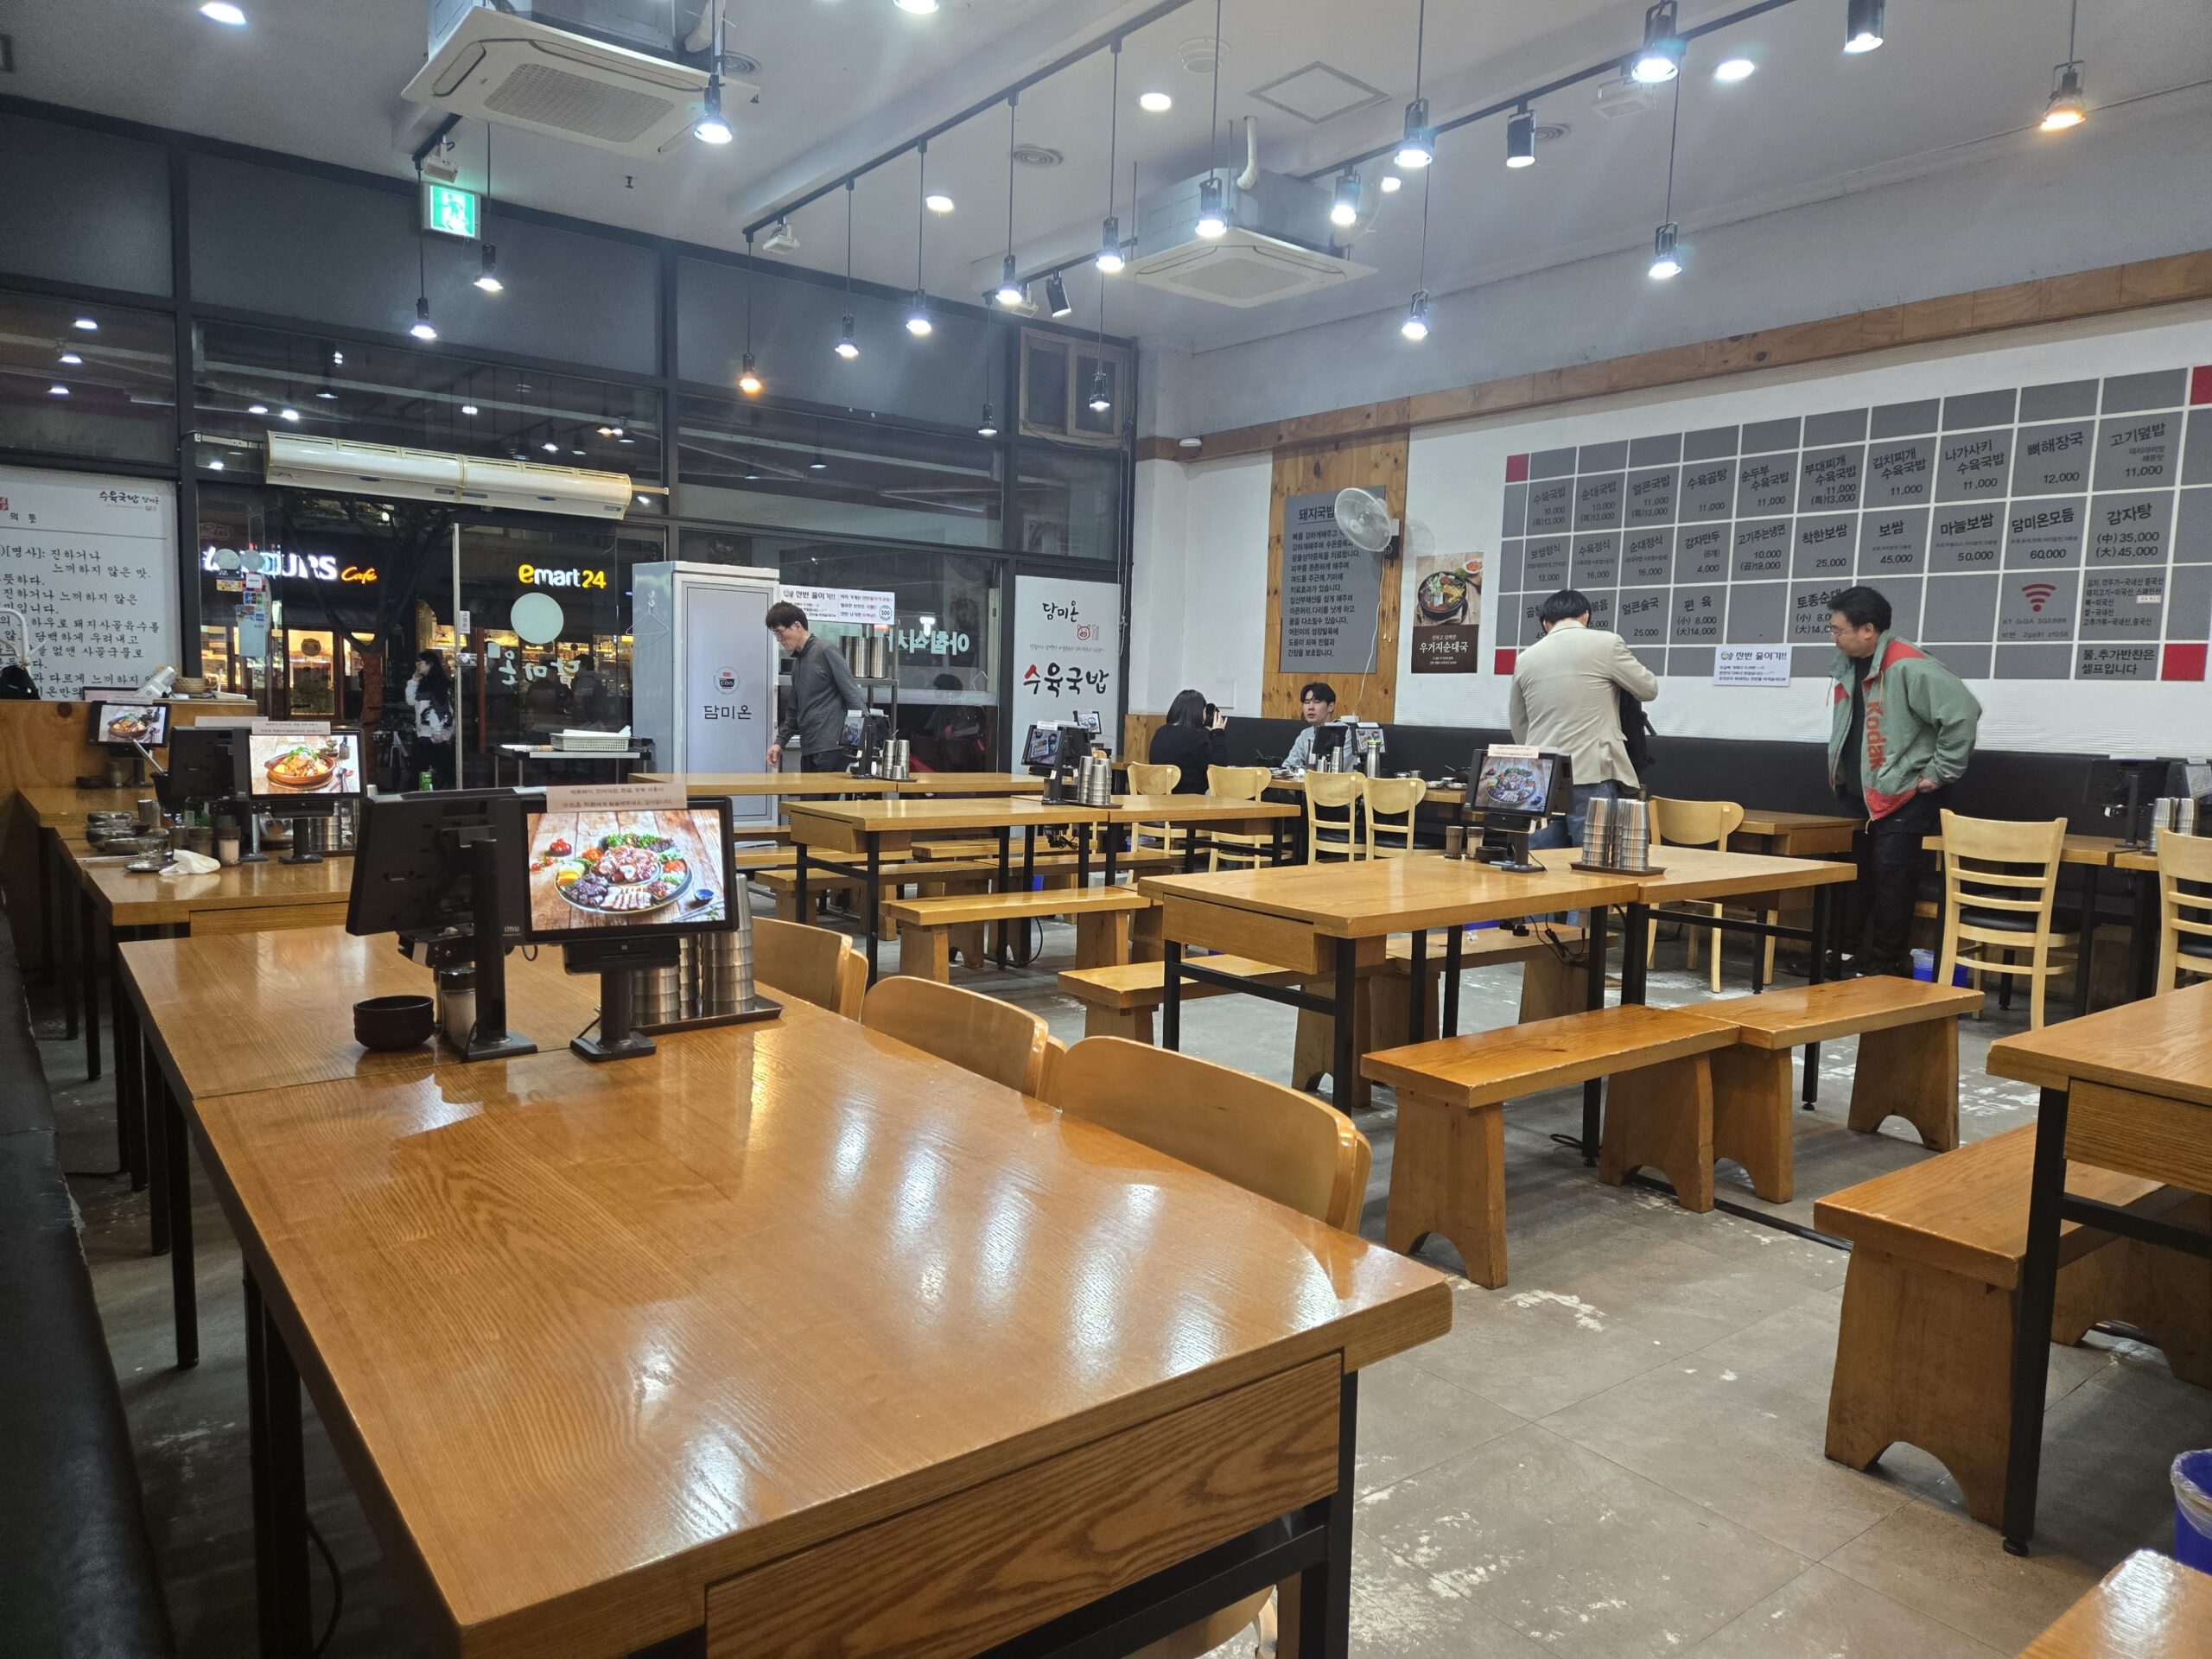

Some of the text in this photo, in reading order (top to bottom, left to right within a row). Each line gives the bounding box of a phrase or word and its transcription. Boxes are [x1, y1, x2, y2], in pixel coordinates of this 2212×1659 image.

[2110, 423, 2166, 447] 고기덮밥
[1872, 447, 1916, 469] 김치찌개
[1945, 439, 1992, 461] 나가사키
[1805, 454, 1847, 475] 부대찌개
[1881, 458, 1926, 480] 수육국밥
[1956, 452, 2005, 474] 수육국밥
[1687, 467, 1728, 490] 수육곰탕
[1740, 465, 1770, 483] 순두부
[1751, 472, 1789, 492] 수육국밥
[1815, 464, 1857, 486] 수육국밥
[1581, 481, 1617, 501] 순대국밥
[1632, 474, 1670, 496] 얼큰국밥
[99, 491, 139, 504] 수육국밥
[1533, 486, 1566, 505] 수육국밥
[1940, 512, 1993, 536] 마늘보쌈
[2012, 507, 2075, 534] 담미온모듬
[2107, 503, 2152, 526] 감자탕
[1738, 524, 1786, 545] 고기주는냉면
[1802, 523, 1848, 545] 착한보쌈
[1878, 520, 1904, 537] 보쌈
[1579, 539, 1611, 556] 수육정식
[1630, 535, 1663, 553] 순대정식
[1685, 531, 1720, 550] 감자만두
[50, 550, 101, 562] 진하거나
[1530, 543, 1561, 560] 보쌈정식
[53, 563, 101, 575] 느끼하지
[108, 567, 131, 578] 않은
[3, 588, 138, 606] 진하거나 느끼하지 않은
[1622, 596, 1660, 616] 얼큰술국
[1042, 600, 1079, 623] 담미온
[17, 617, 68, 629] 하우로
[35, 631, 84, 644] 담백하게
[90, 633, 139, 645] 우려내고
[1419, 641, 1469, 654] 우거지순대국
[53, 645, 144, 658] 없앤 사골국물로
[49, 674, 138, 684] 다르게 느끼하지
[1023, 662, 1109, 698] 수육국밥
[703, 704, 753, 720] 담미온
[1866, 701, 1888, 772] Kodak
